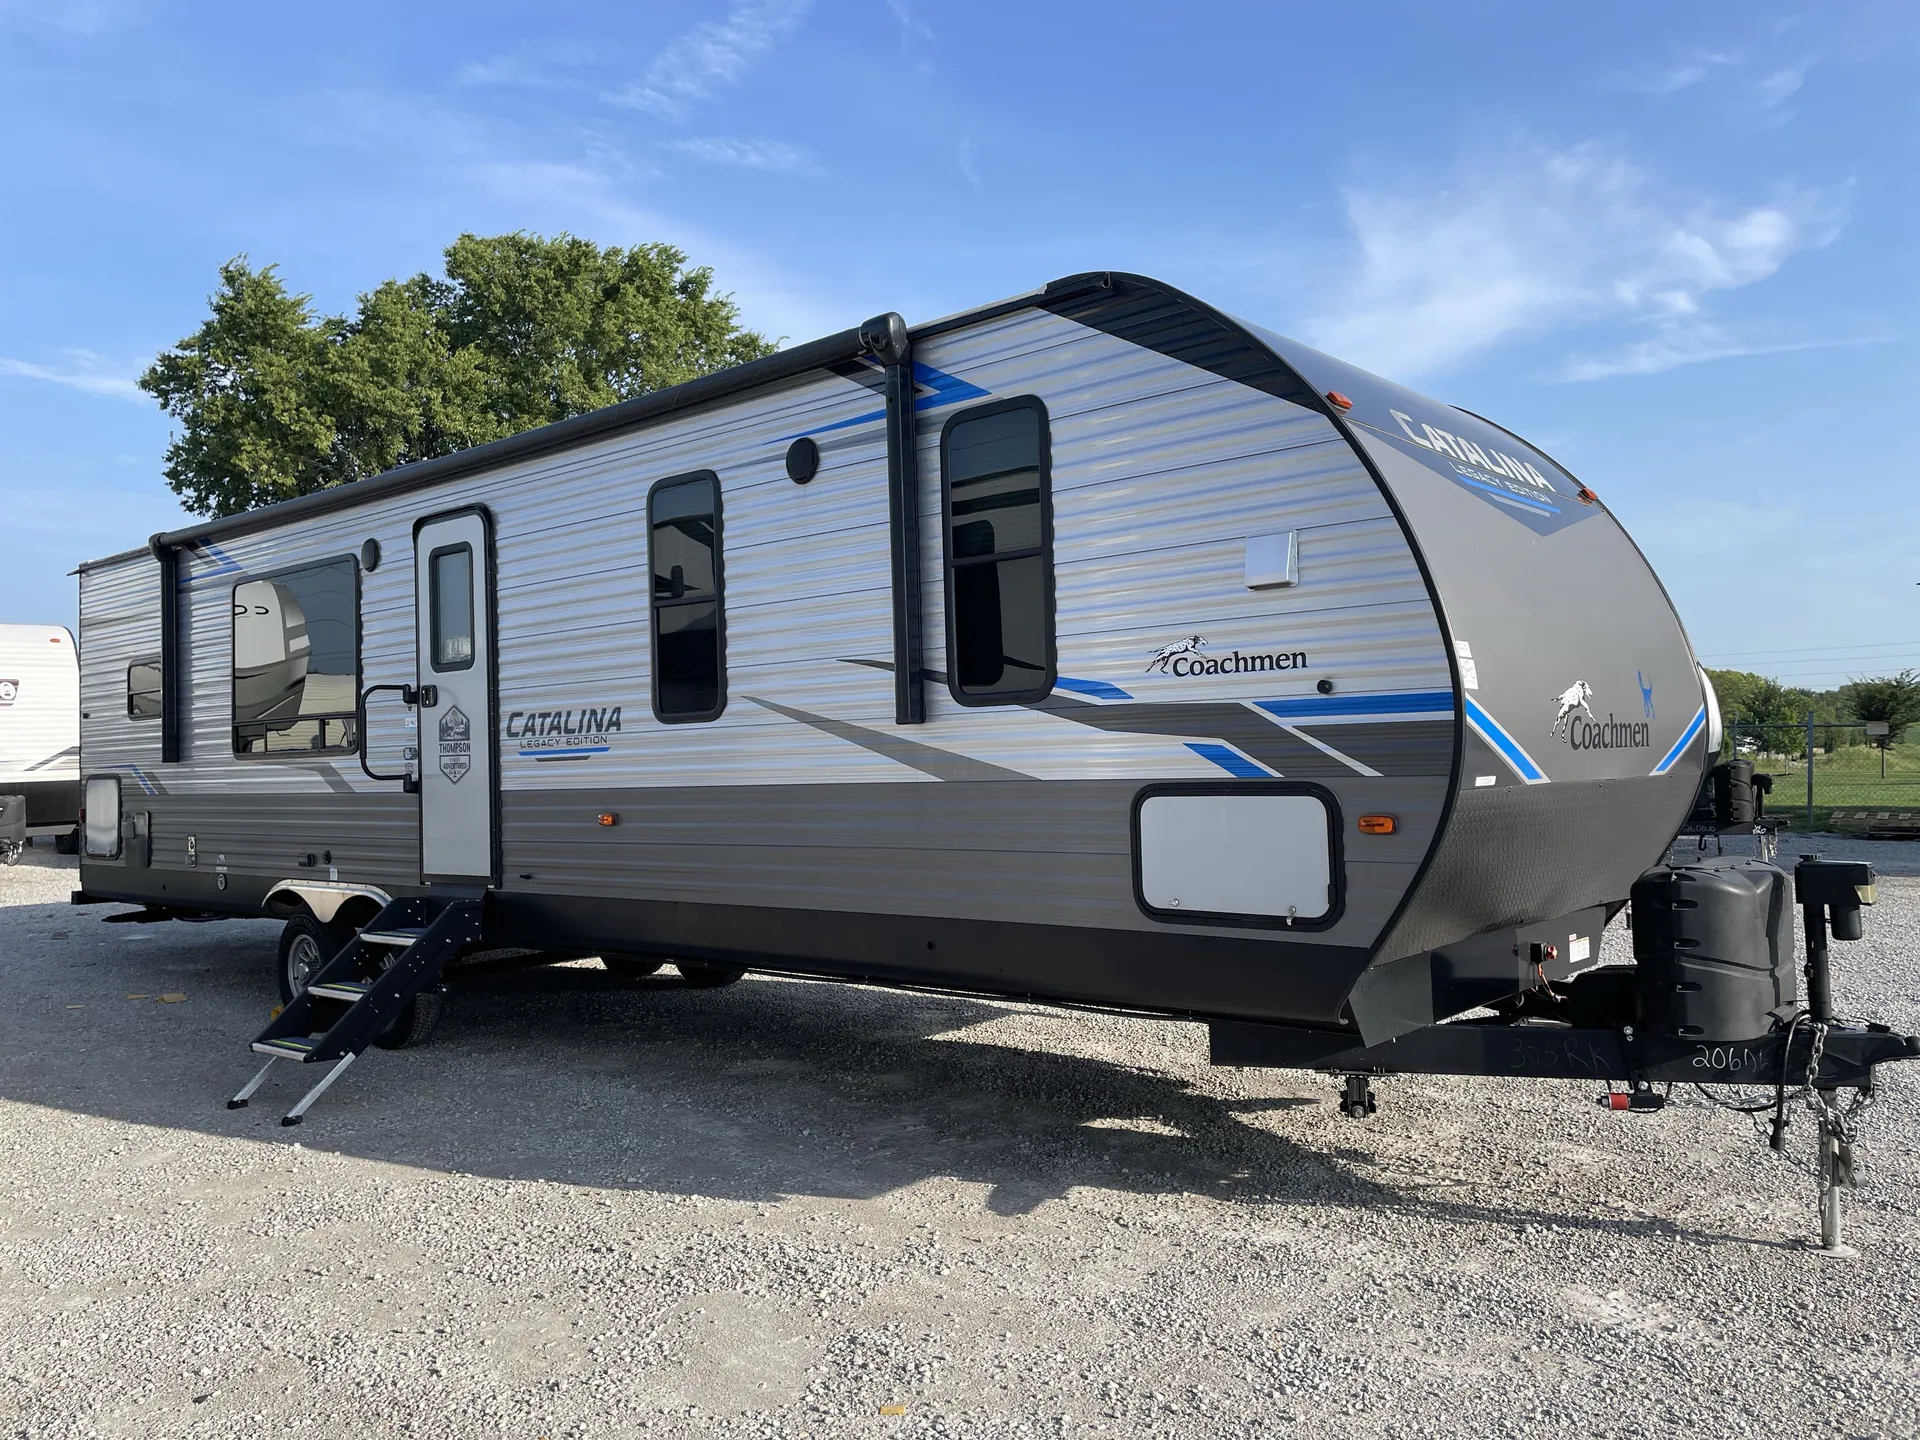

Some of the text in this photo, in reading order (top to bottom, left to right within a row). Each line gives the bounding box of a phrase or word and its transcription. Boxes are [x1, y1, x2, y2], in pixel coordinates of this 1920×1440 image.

[1389, 409, 1556, 492] CATALINA
[1449, 462, 1553, 504] LEGACY EDITION
[1172, 650, 1309, 678] Coachmen
[506, 706, 622, 738] CATALINA
[1570, 712, 1650, 751] Coachmen
[439, 742, 471, 754] THOMPSON
[520, 735, 608, 749] LEGACY EDITION
